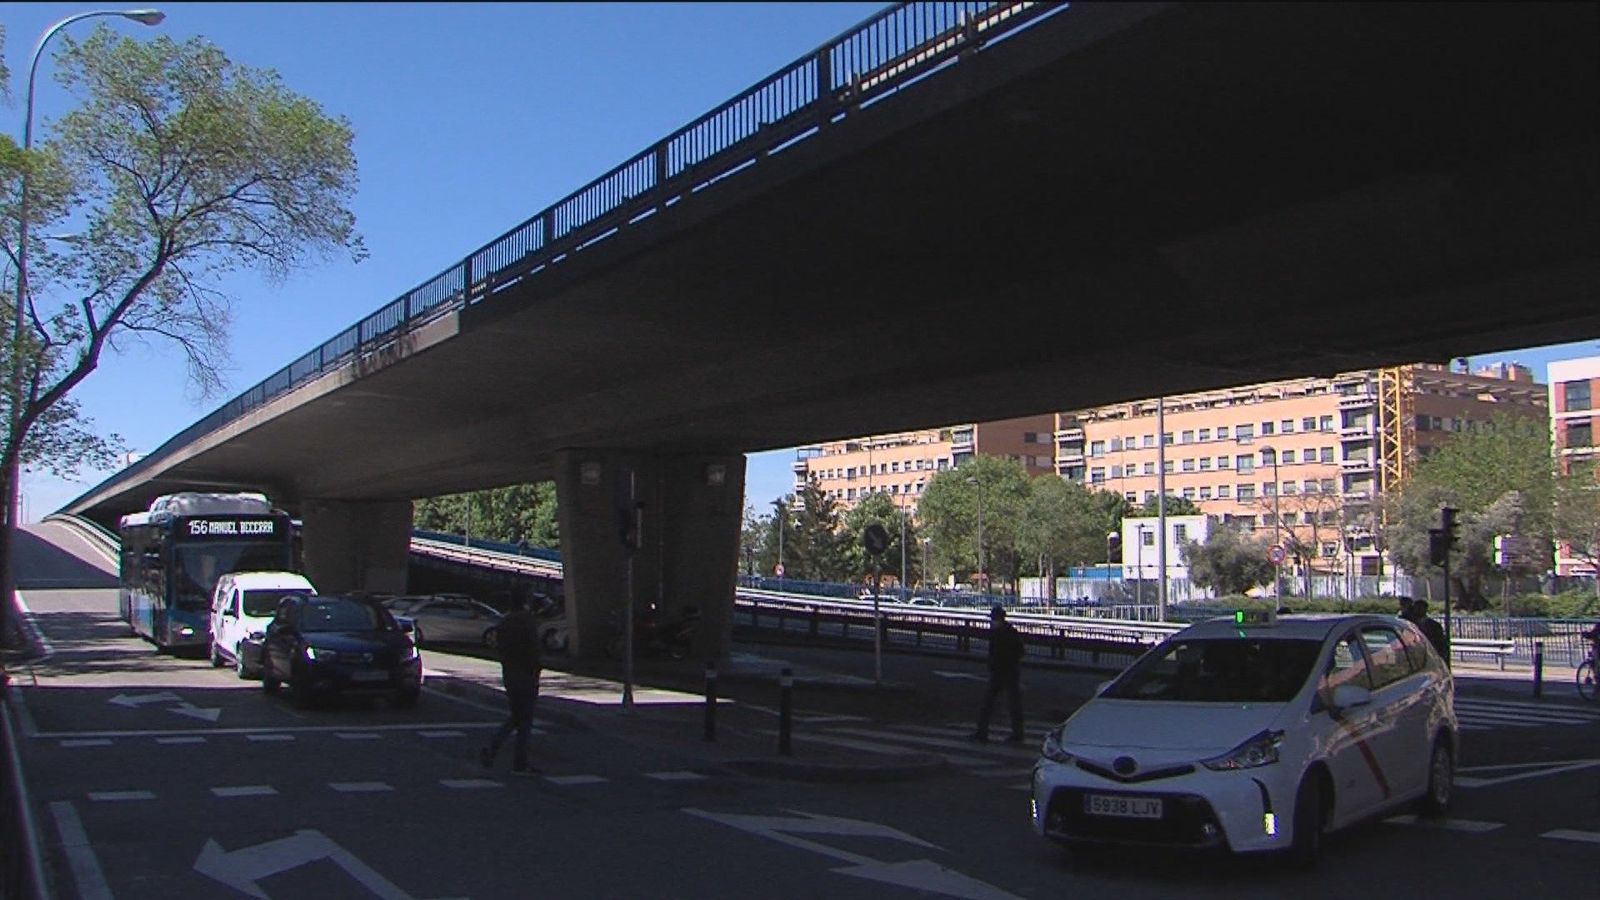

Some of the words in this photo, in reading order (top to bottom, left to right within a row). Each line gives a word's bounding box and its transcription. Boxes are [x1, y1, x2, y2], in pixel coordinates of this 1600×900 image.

[189, 520, 208, 534] 156
[208, 521, 238, 534] MANUEL
[240, 521, 273, 534] BECERRA
[1093, 798, 1128, 814] 5938
